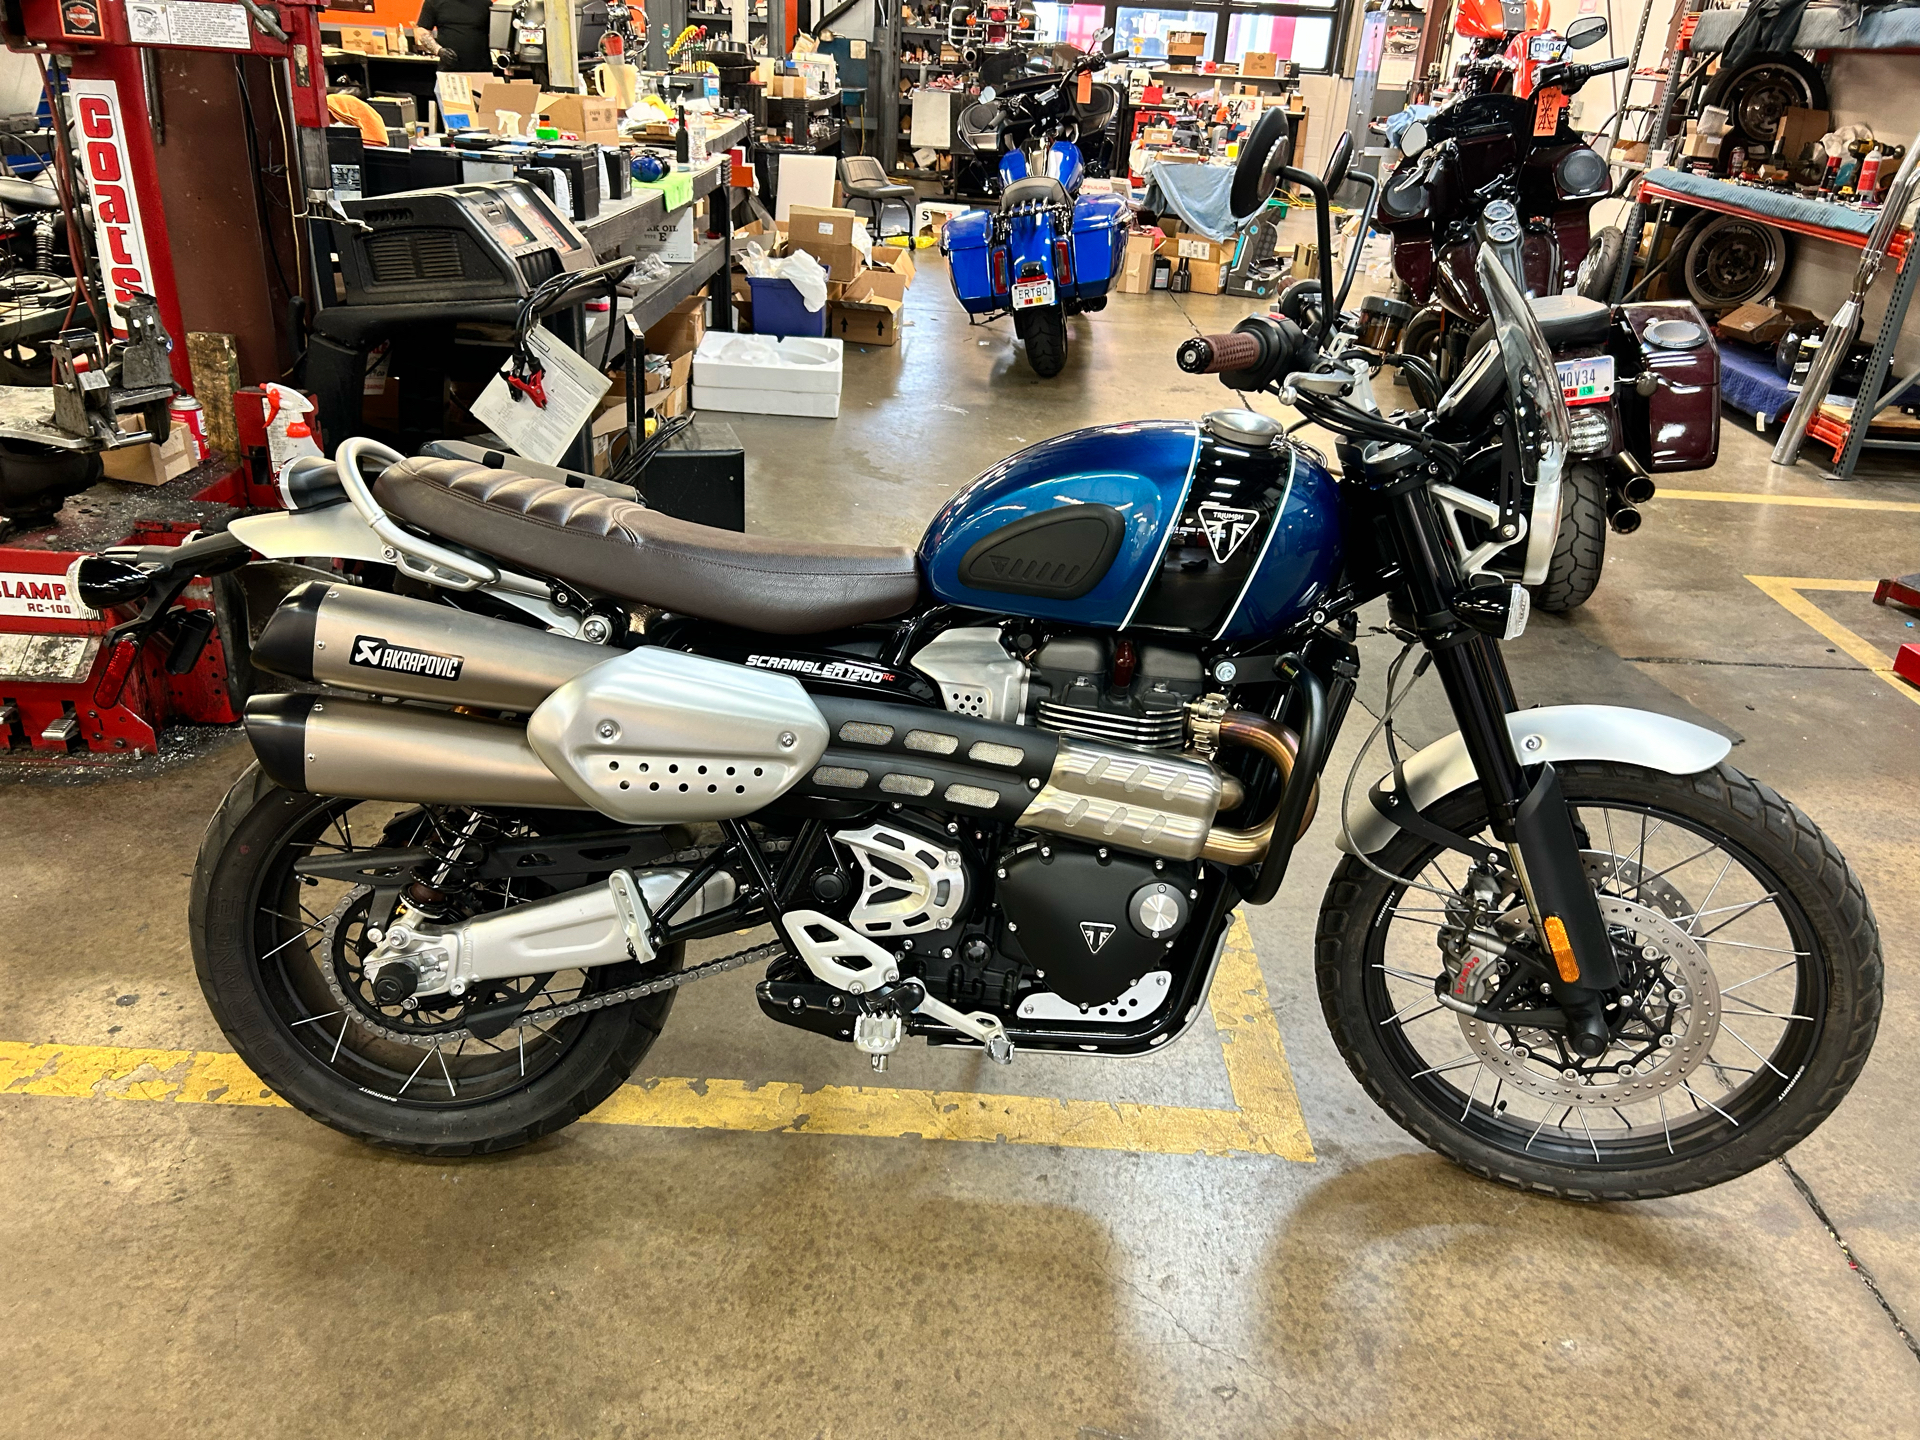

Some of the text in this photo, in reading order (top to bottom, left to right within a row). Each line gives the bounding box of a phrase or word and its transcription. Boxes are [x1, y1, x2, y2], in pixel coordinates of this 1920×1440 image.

[658, 232, 667, 241] E
[1213, 511, 1244, 520] TRIUMPH
[27, 602, 71, 614] RC-100
[745, 654, 844, 678] SCRAMBLER
[1454, 956, 1480, 994] brembo
